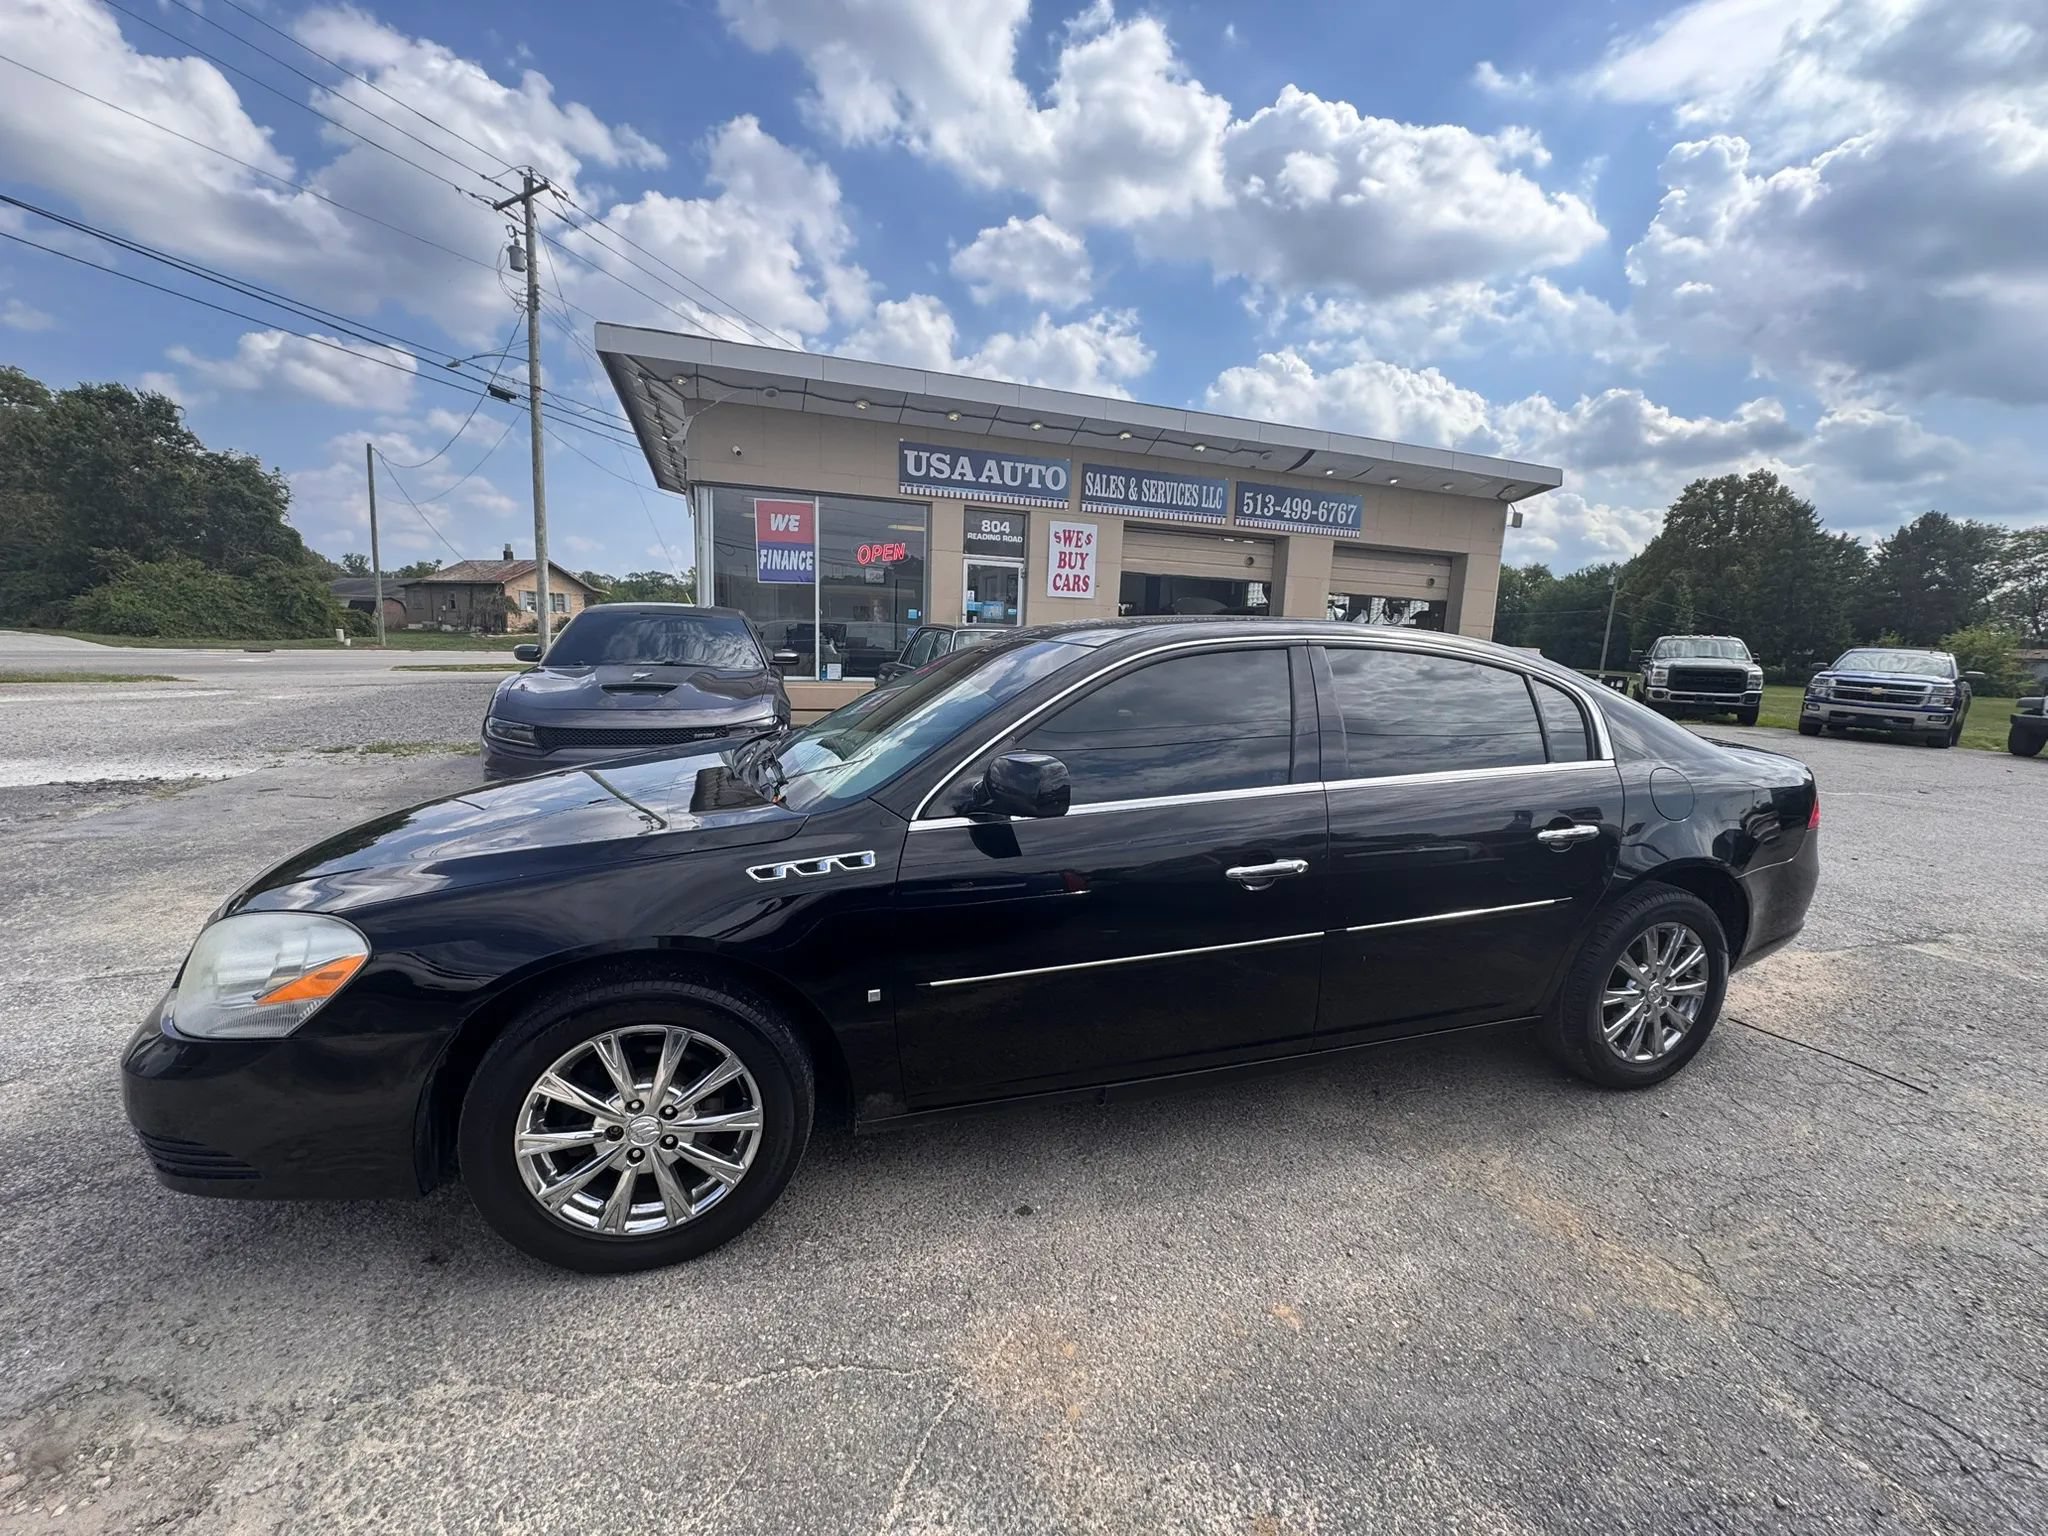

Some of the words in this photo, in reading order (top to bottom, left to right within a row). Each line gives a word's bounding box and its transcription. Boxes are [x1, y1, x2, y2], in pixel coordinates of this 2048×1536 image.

[904, 450, 976, 481] USA
[978, 459, 1066, 491] AUTO
[1085, 471, 1124, 498] SALES
[1128, 477, 1138, 500] &
[1141, 479, 1199, 507] SERVICES
[1202, 485, 1223, 510] LLC
[1243, 492, 1358, 526] 513-499-6767
[770, 513, 801, 532] WE
[981, 520, 1010, 534] 804
[967, 532, 1001, 542] READING
[1002, 535, 1023, 543] ROAD
[760, 548, 814, 571] FINANCE
[857, 542, 906, 565] OPEN
[1057, 551, 1089, 570] BUY
[1053, 573, 1090, 592] CARS
